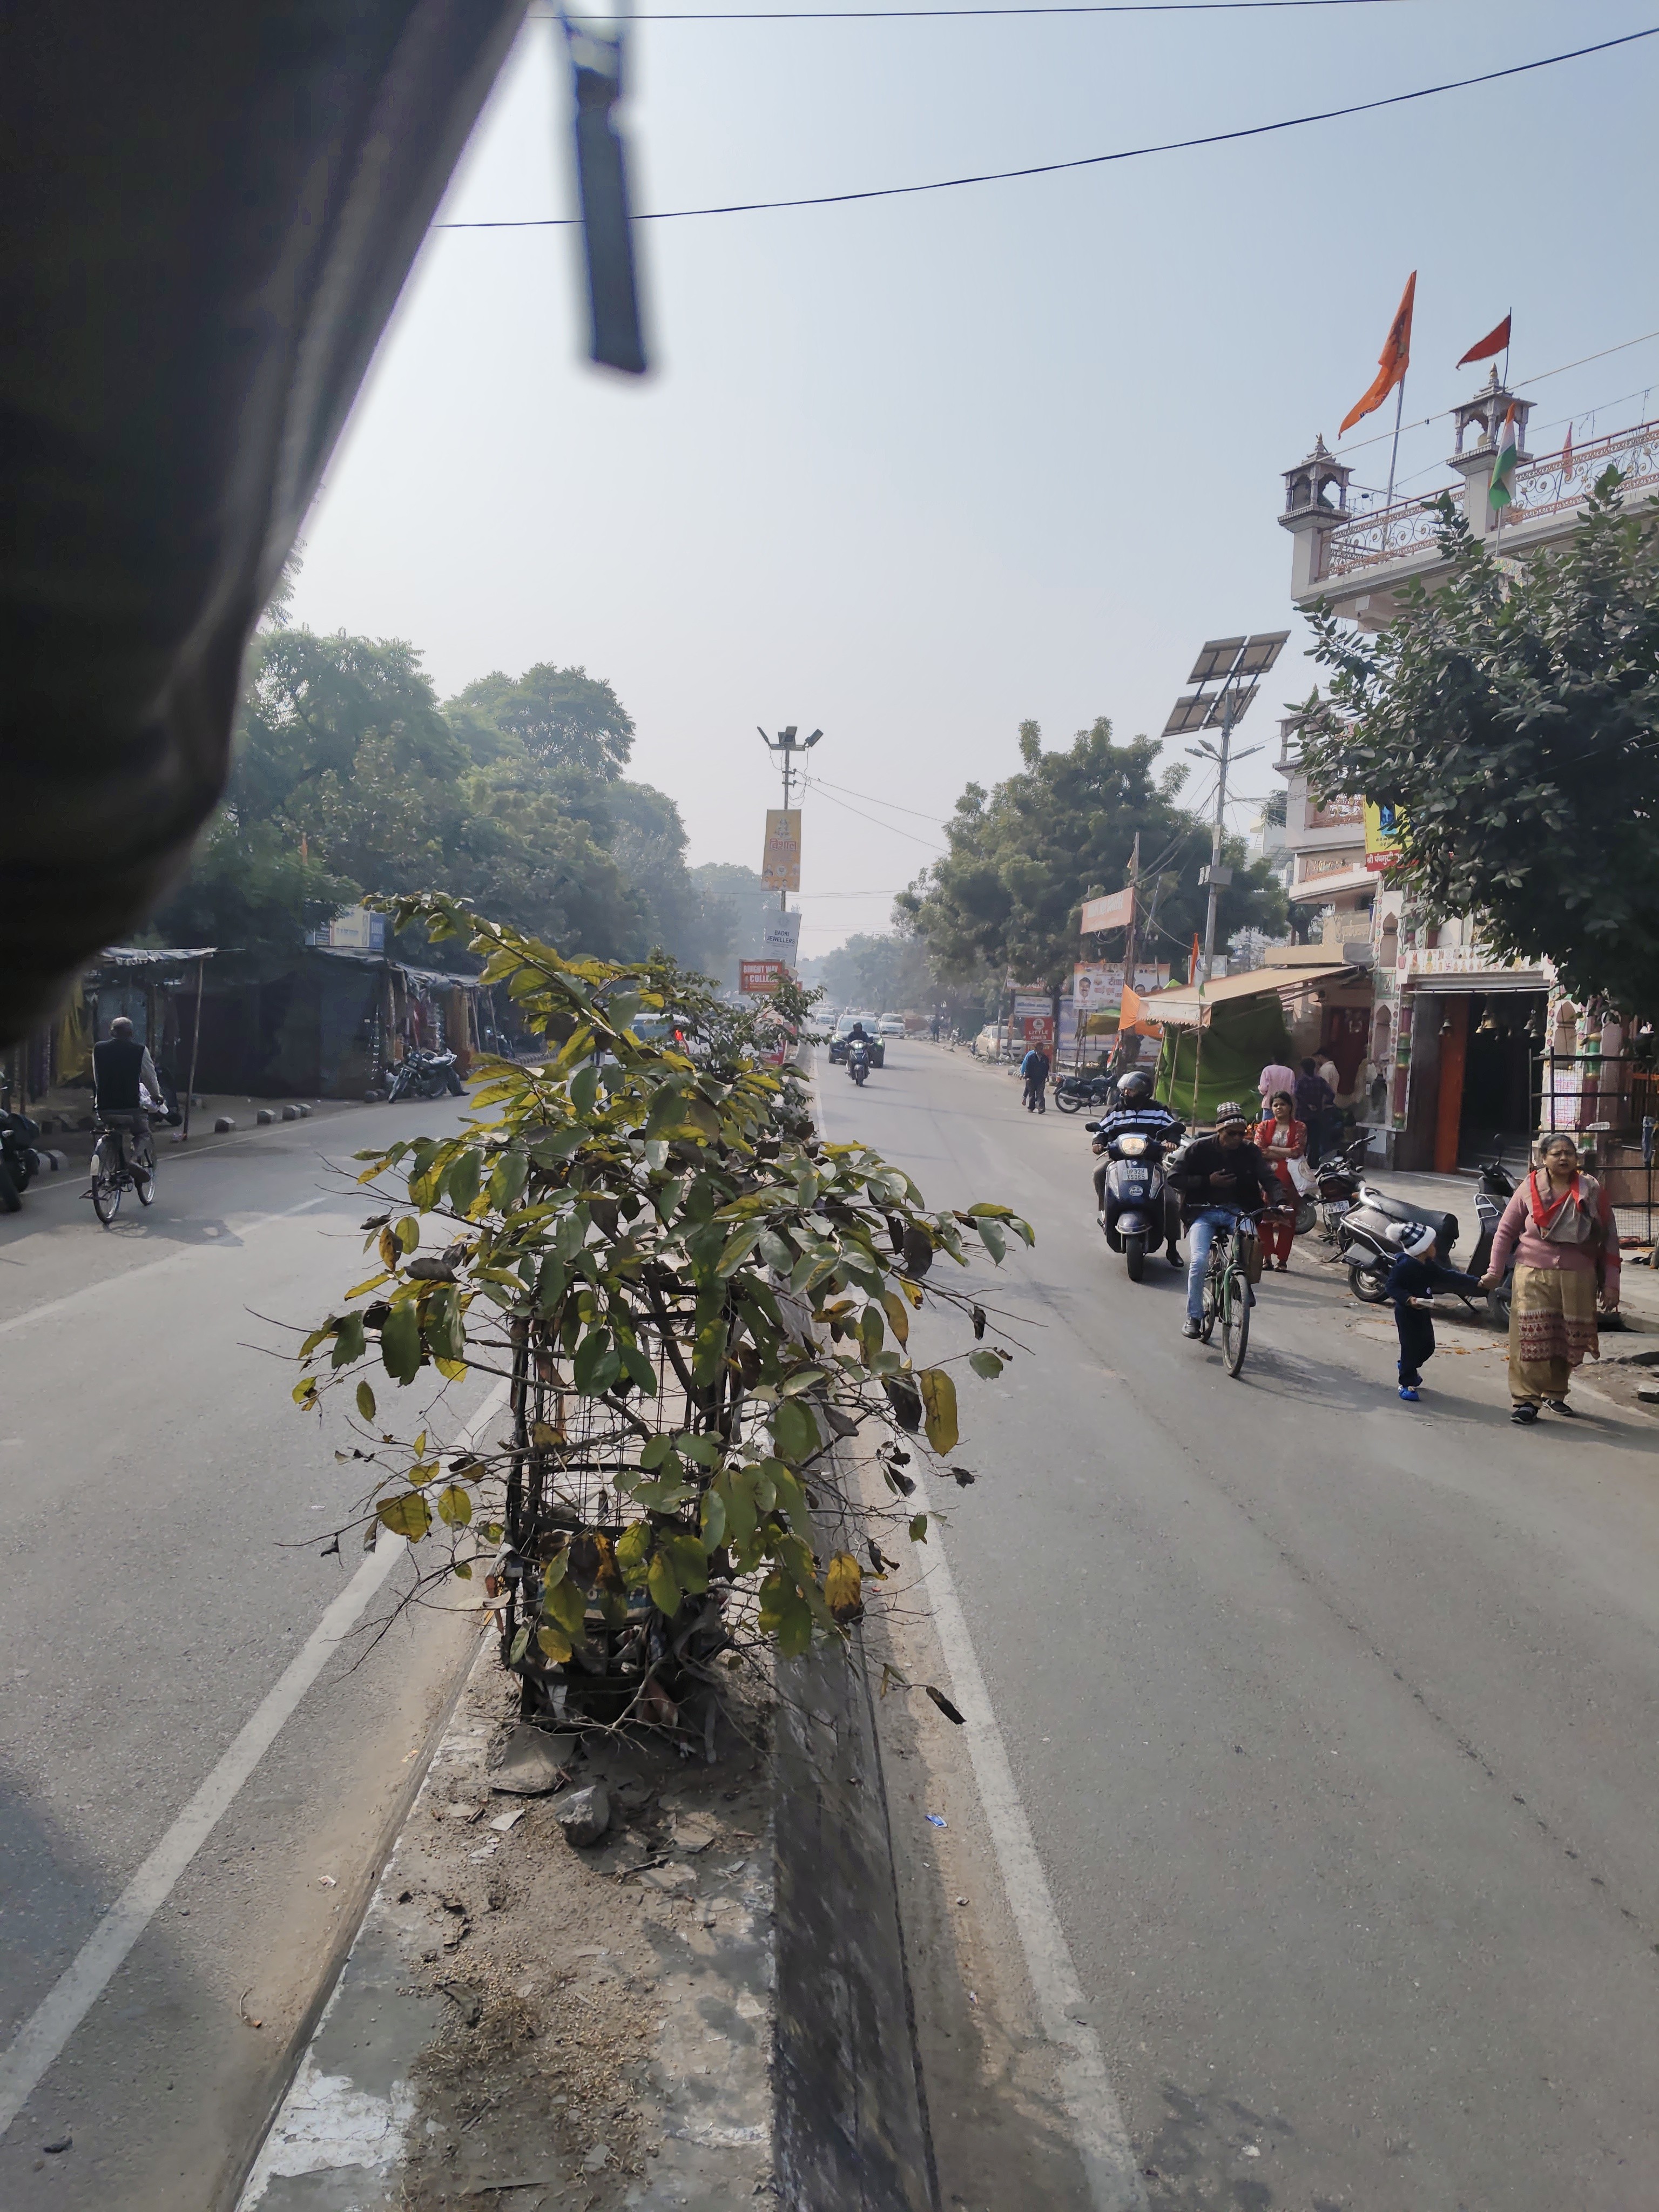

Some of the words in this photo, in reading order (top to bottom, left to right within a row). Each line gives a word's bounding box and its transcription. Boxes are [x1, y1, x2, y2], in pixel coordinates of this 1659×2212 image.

[769, 838, 797, 851] विशाल
[767, 936, 795, 944] JEWELLERS
[743, 965, 765, 973] BRIGHT
[765, 965, 778, 973] WAY
